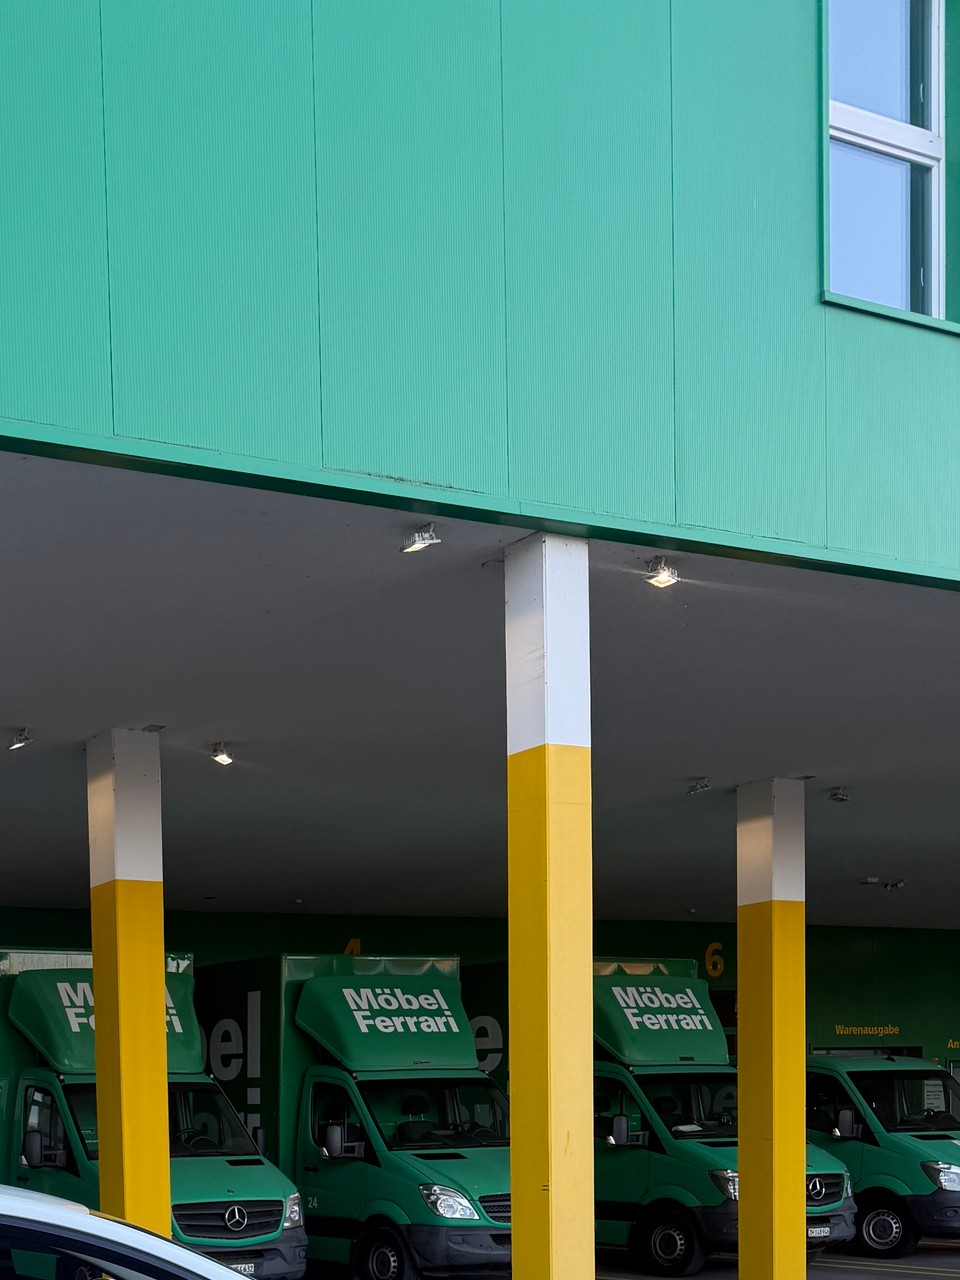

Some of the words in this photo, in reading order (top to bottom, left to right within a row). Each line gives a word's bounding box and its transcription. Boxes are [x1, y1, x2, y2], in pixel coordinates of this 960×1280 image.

[705, 942, 725, 978] 6
[341, 988, 449, 1010] Möbel
[611, 986, 702, 1009] Möbel
[352, 1011, 460, 1033] Ferrari
[622, 1008, 714, 1031] Ferrari
[834, 1024, 901, 1037] Warenausgabe
[307, 1196, 319, 1209] 24
